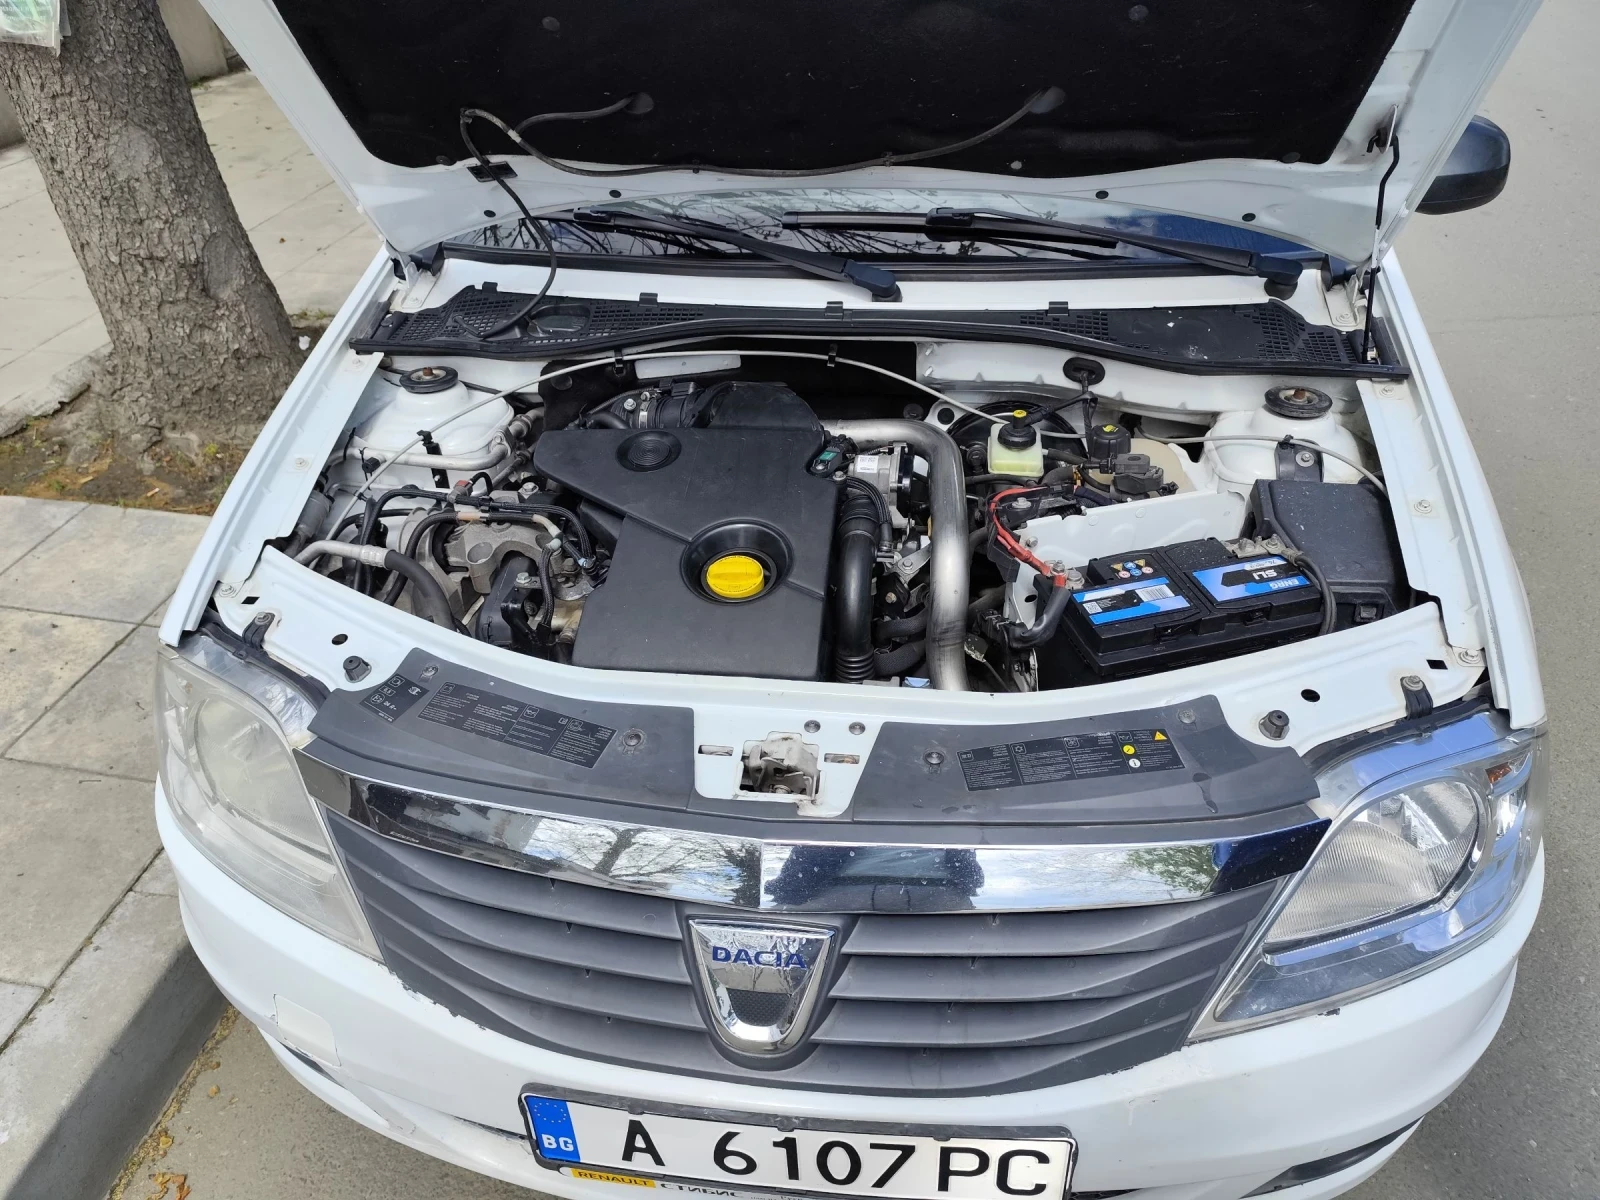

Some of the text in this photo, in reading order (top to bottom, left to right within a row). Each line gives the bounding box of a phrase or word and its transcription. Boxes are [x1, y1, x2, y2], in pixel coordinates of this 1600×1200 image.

[1252, 569, 1278, 580] SLI
[712, 946, 807, 969] DACIA
[541, 1133, 574, 1152] BG
[621, 1119, 1051, 1197] A 6107 PC
[577, 1171, 650, 1186] RENAULT
